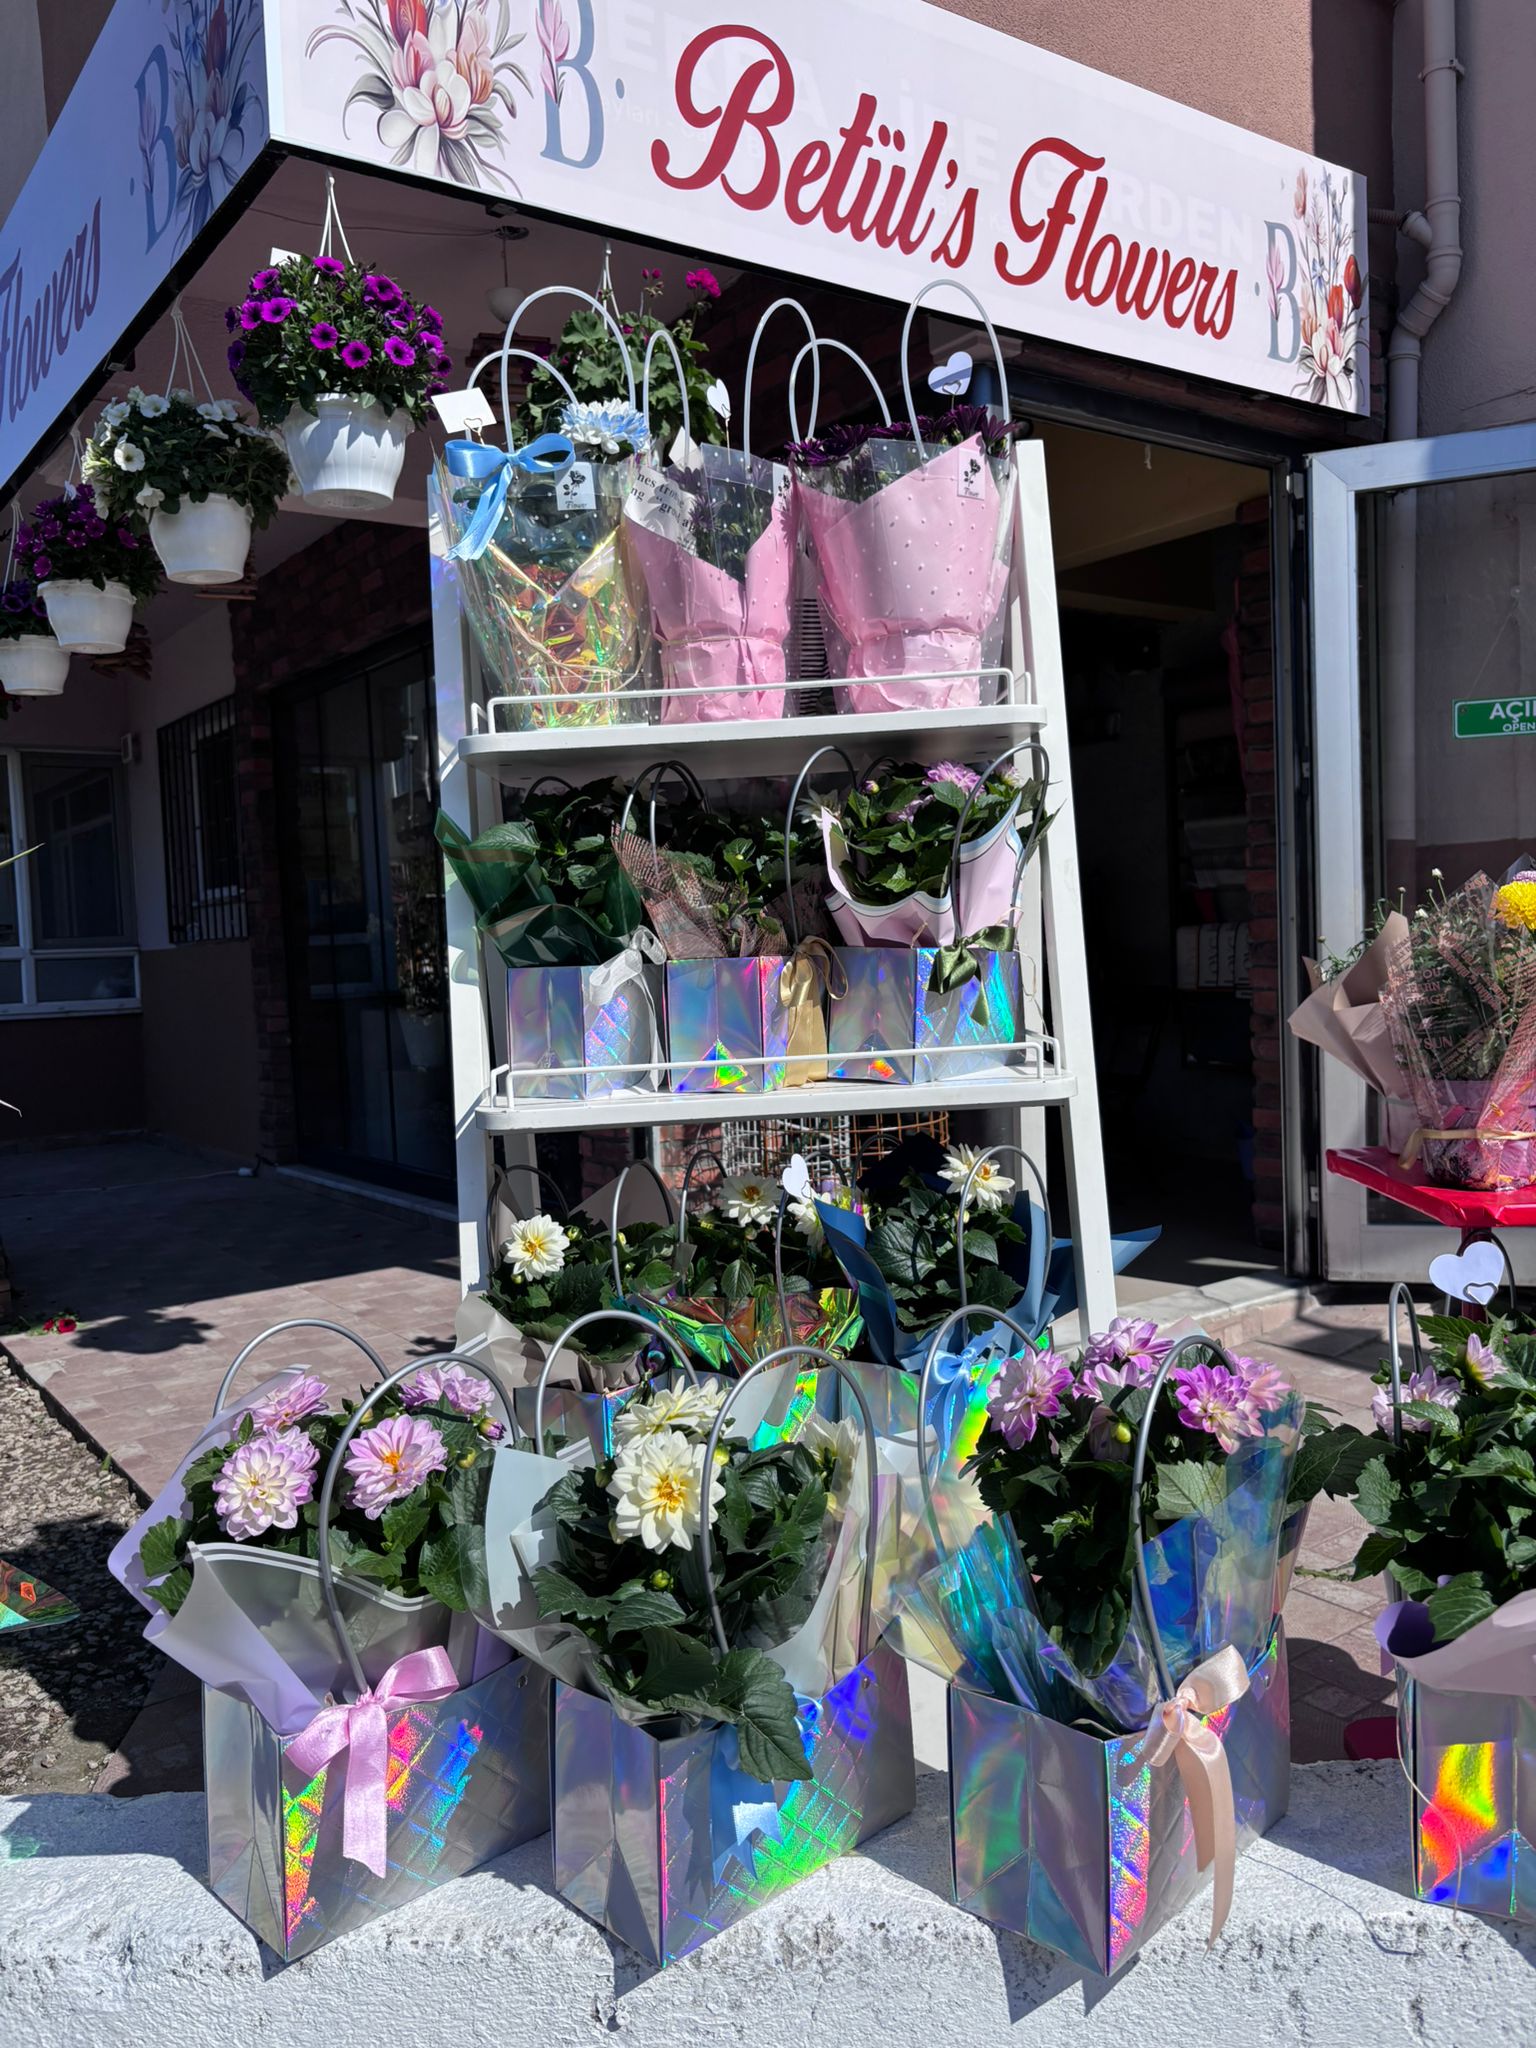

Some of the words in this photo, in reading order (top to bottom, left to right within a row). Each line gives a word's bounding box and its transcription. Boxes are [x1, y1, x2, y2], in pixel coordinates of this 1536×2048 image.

[651, 24, 978, 269] Betül's
[995, 137, 1238, 342] Flowers
[1489, 700, 1536, 723] AÇI
[1503, 722, 1536, 732] OPEN
